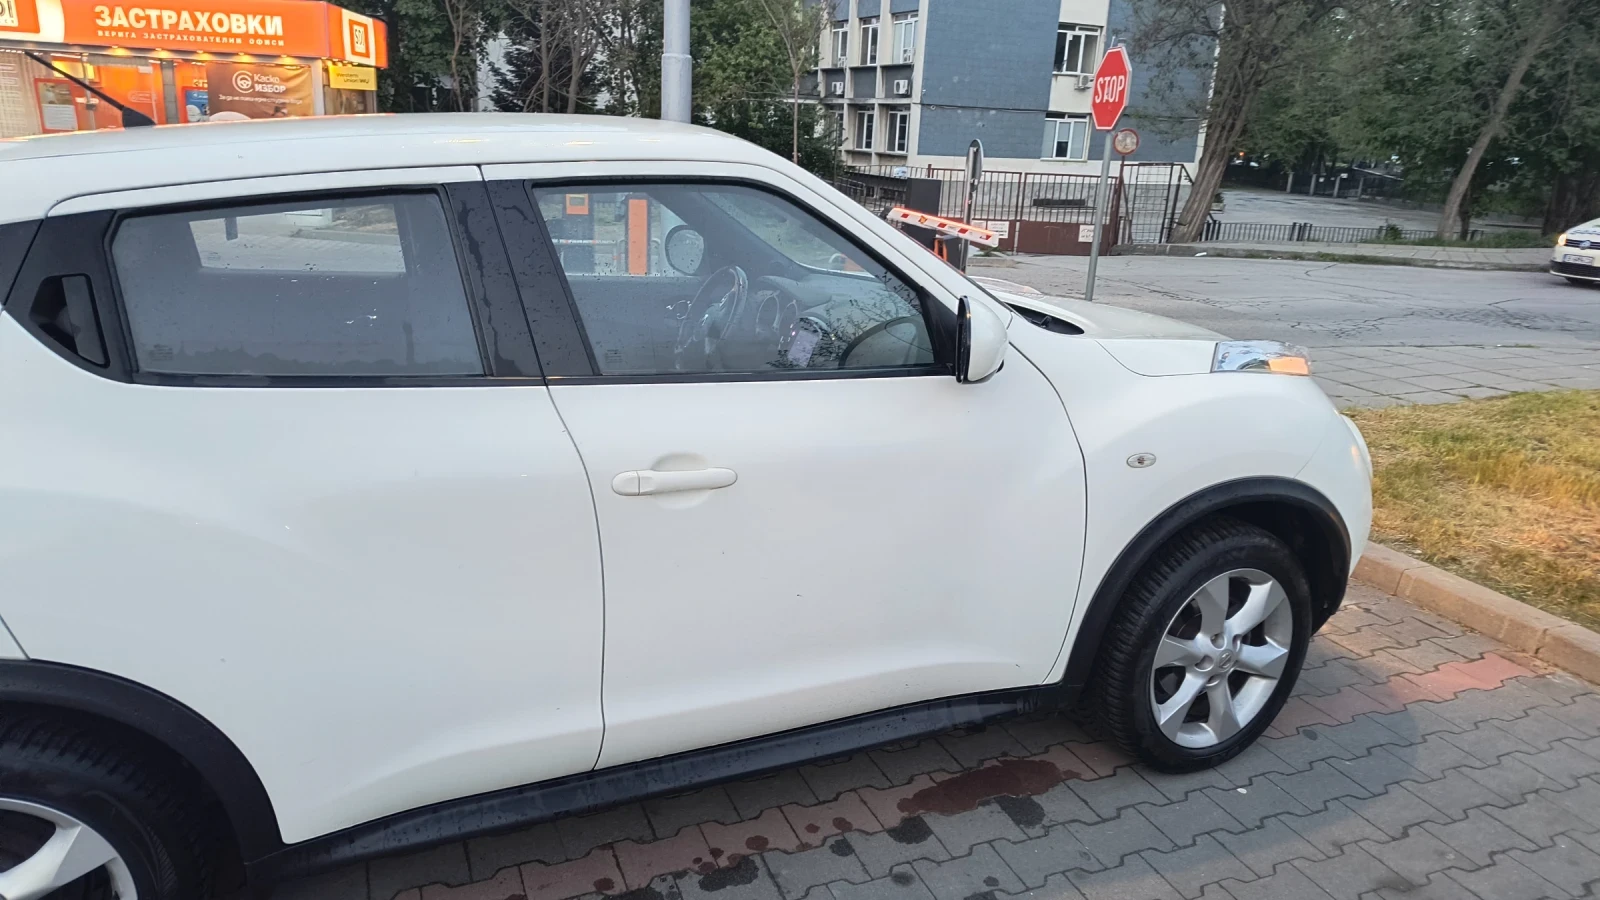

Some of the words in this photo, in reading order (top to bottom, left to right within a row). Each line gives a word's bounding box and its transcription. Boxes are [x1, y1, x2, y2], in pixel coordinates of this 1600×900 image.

[94, 5, 284, 37] ЗАСТРАХОВКИ
[97, 30, 137, 39] ВЕРИГА
[143, 32, 242, 44] ЗАСТРАХОВАТЕЛНИ
[248, 38, 285, 46] ОФИСИ
[253, 73, 280, 84] Каско
[254, 83, 286, 93] ИЗБОР
[1095, 75, 1125, 103] STOP
